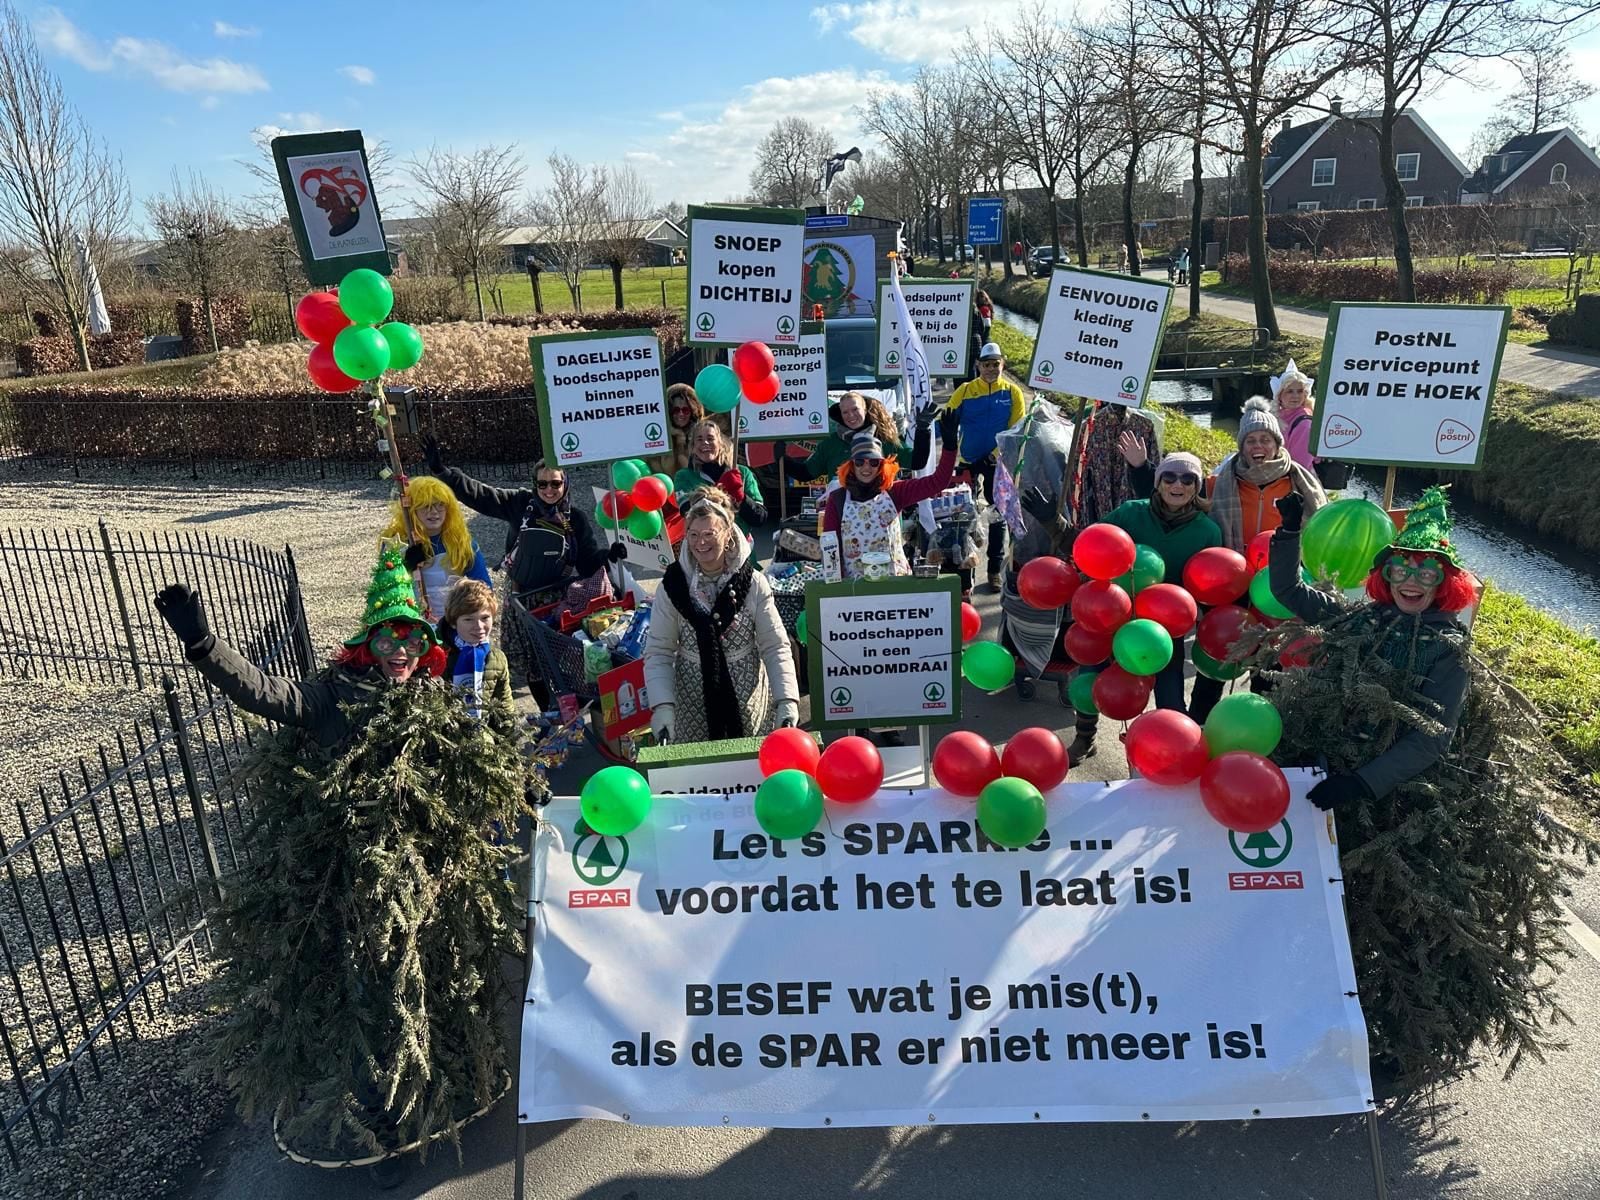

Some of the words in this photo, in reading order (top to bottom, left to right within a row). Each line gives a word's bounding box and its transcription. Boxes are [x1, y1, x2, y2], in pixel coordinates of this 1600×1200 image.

[715, 235, 781, 252] SNOEP
[719, 260, 775, 279] kopen
[700, 285, 791, 303] DICHTBIJ
[1060, 285, 1158, 312] EENVOUDIG
[939, 307, 952, 315] de
[891, 322, 922, 330] TR
[927, 321, 940, 331] bij
[944, 321, 957, 329] de
[1074, 309, 1134, 332] kleding
[893, 336, 954, 344] s/finish
[1079, 331, 1118, 348] laten
[1375, 331, 1456, 347] PostNL
[557, 348, 652, 366] DAGELIJKSE
[1064, 351, 1122, 370] stomen
[1344, 357, 1480, 376] servicepunt
[554, 367, 660, 386] boodschappen
[585, 389, 633, 401] binnen
[772, 392, 807, 402] KEND
[1334, 382, 1369, 396] OM
[1377, 383, 1407, 397] DE
[1415, 384, 1482, 400] HOEK
[562, 402, 660, 423] HANDBEREIK
[759, 408, 804, 420] gezicht
[1328, 428, 1357, 437] postnl
[1440, 433, 1470, 442] postnl
[627, 536, 646, 547] laat
[648, 542, 660, 551] is!
[830, 628, 943, 641] boodschappen
[864, 647, 877, 657] in
[882, 647, 910, 656] een
[827, 661, 948, 677] HANDOMDRAAI
[1070, 840, 1112, 850] ...
[1232, 873, 1301, 888] SPAR
[572, 891, 629, 905] SPAR
[656, 876, 838, 915] voordat
[856, 874, 935, 909] het
[952, 873, 1002, 908] te
[1020, 870, 1116, 906] laat
[1134, 868, 1191, 903] is!
[686, 982, 832, 1016] BESEF
[848, 980, 934, 1013] wat
[948, 977, 991, 1020] je
[1008, 972, 1157, 1014] mis(t),
[612, 1032, 676, 1066] als
[692, 1033, 742, 1067] de
[760, 1033, 882, 1068] SPAR
[898, 1038, 945, 1065] er
[962, 1028, 1051, 1063] niet
[1067, 1033, 1190, 1060] meer
[1207, 1023, 1266, 1059] is!
